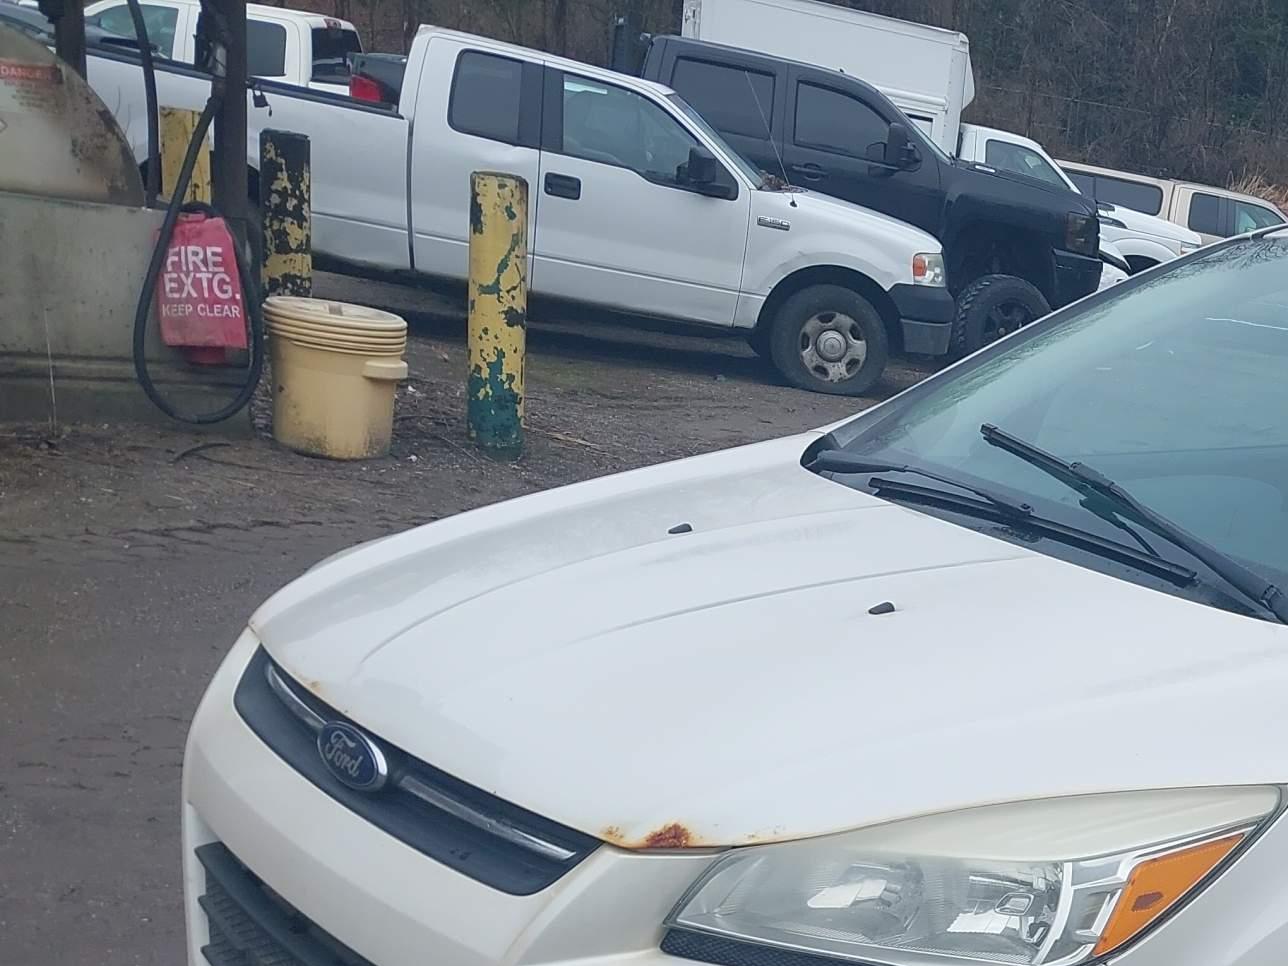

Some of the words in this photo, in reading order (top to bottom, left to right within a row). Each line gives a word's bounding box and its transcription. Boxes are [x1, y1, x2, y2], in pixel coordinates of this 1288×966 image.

[166, 245, 225, 272] FIRE
[164, 272, 241, 300] EXTG.
[162, 304, 193, 318] KEEP
[197, 304, 241, 318] CLEAR
[324, 730, 364, 777] Ford
